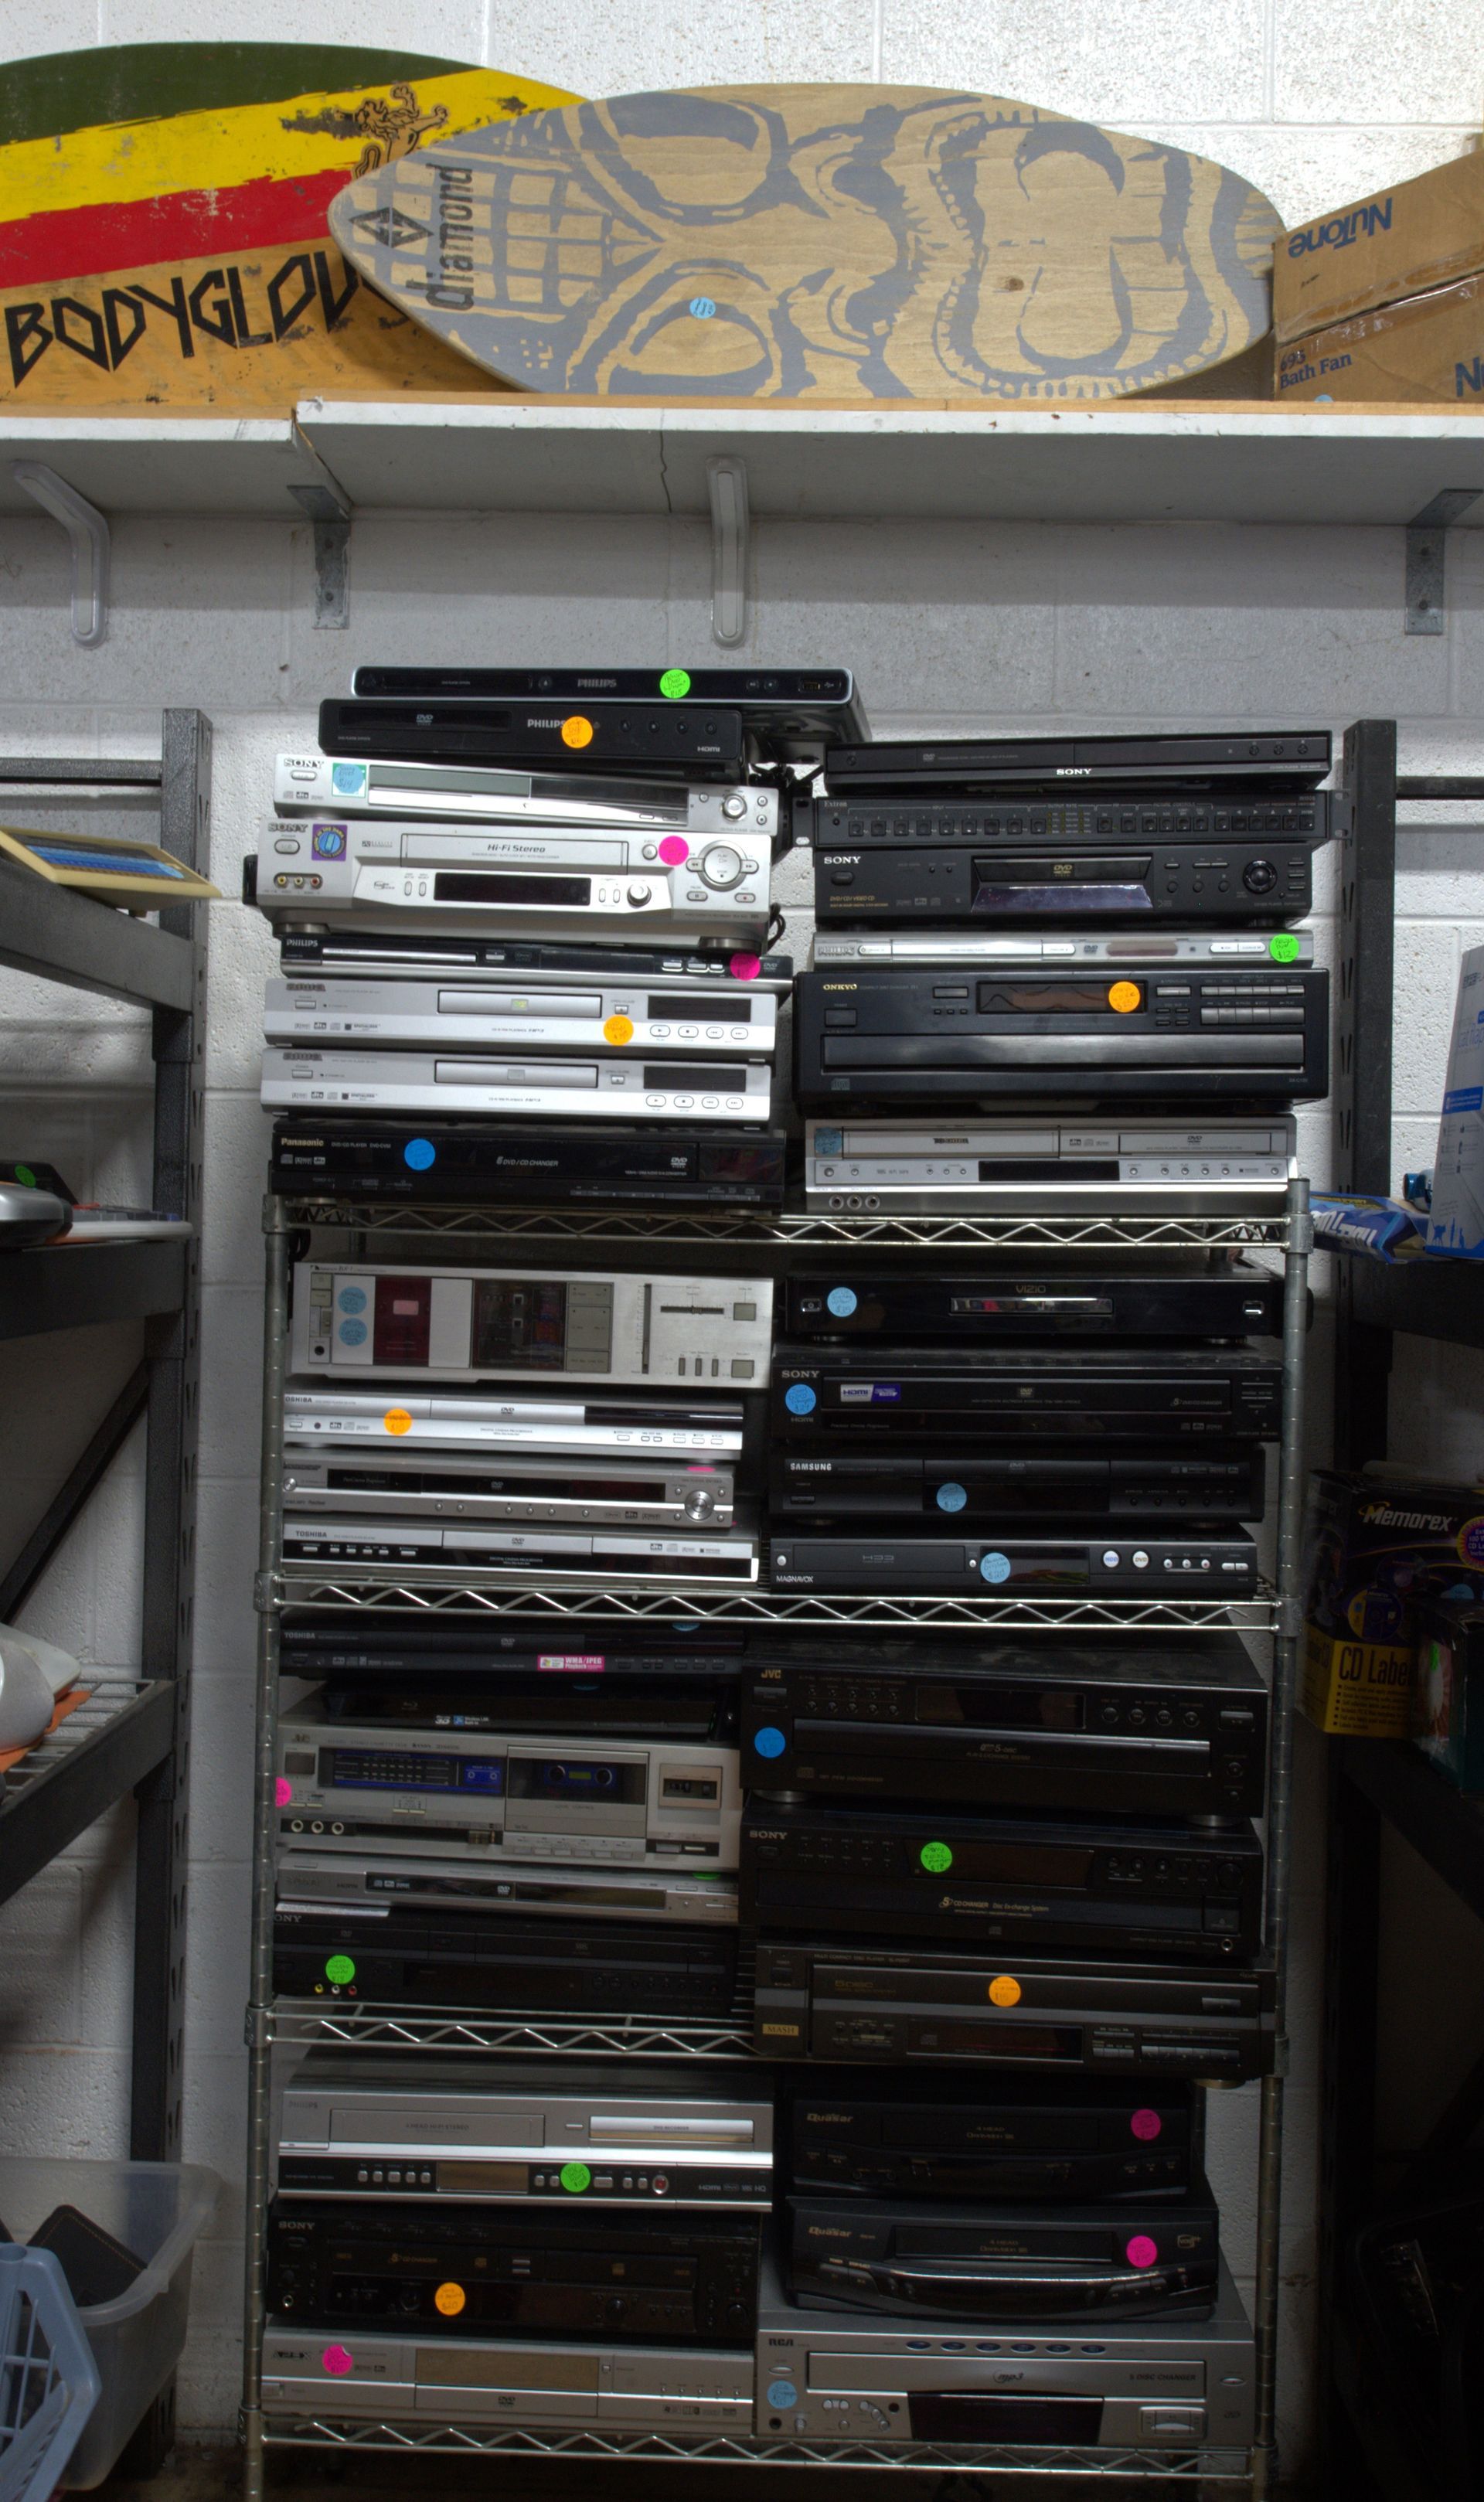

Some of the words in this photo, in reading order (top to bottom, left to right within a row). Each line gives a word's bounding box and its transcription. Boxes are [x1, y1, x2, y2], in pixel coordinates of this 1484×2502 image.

[1288, 197, 1392, 258] NuTone
[406, 163, 474, 310] diamond
[6, 250, 398, 389] BODYGLOV
[1280, 350, 1305, 371] 695
[1280, 365, 1315, 390] Bath
[1319, 353, 1353, 376] Fan
[577, 678, 617, 688] PHILIPS
[284, 757, 324, 768] SONY
[267, 822, 308, 833] SONY
[487, 843, 511, 852] Hi-Fi
[512, 845, 546, 853] Stereo
[824, 856, 861, 865] SONY
[1053, 863, 1073, 872] DVD
[287, 938, 318, 947] PHILIPS
[281, 1137, 325, 1147] Panasonic
[1015, 1284, 1047, 1294] VIZIO
[781, 1369, 820, 1379] SONY
[790, 1462, 832, 1471] SAMSUNG
[1363, 1503, 1453, 1532] Memorex
[776, 1575, 814, 1584] MAGNAVOX
[1338, 1645, 1363, 1681] CD
[761, 1669, 782, 1680] JVC
[749, 1830, 788, 1840] SONY
[274, 1915, 302, 1923] ONY
[768, 2025, 795, 2034] MASH
[806, 2112, 853, 2123] Quasar
[278, 2221, 315, 2231] SONY
[808, 2225, 852, 2238] Quasar
[768, 2337, 794, 2347] RCA
